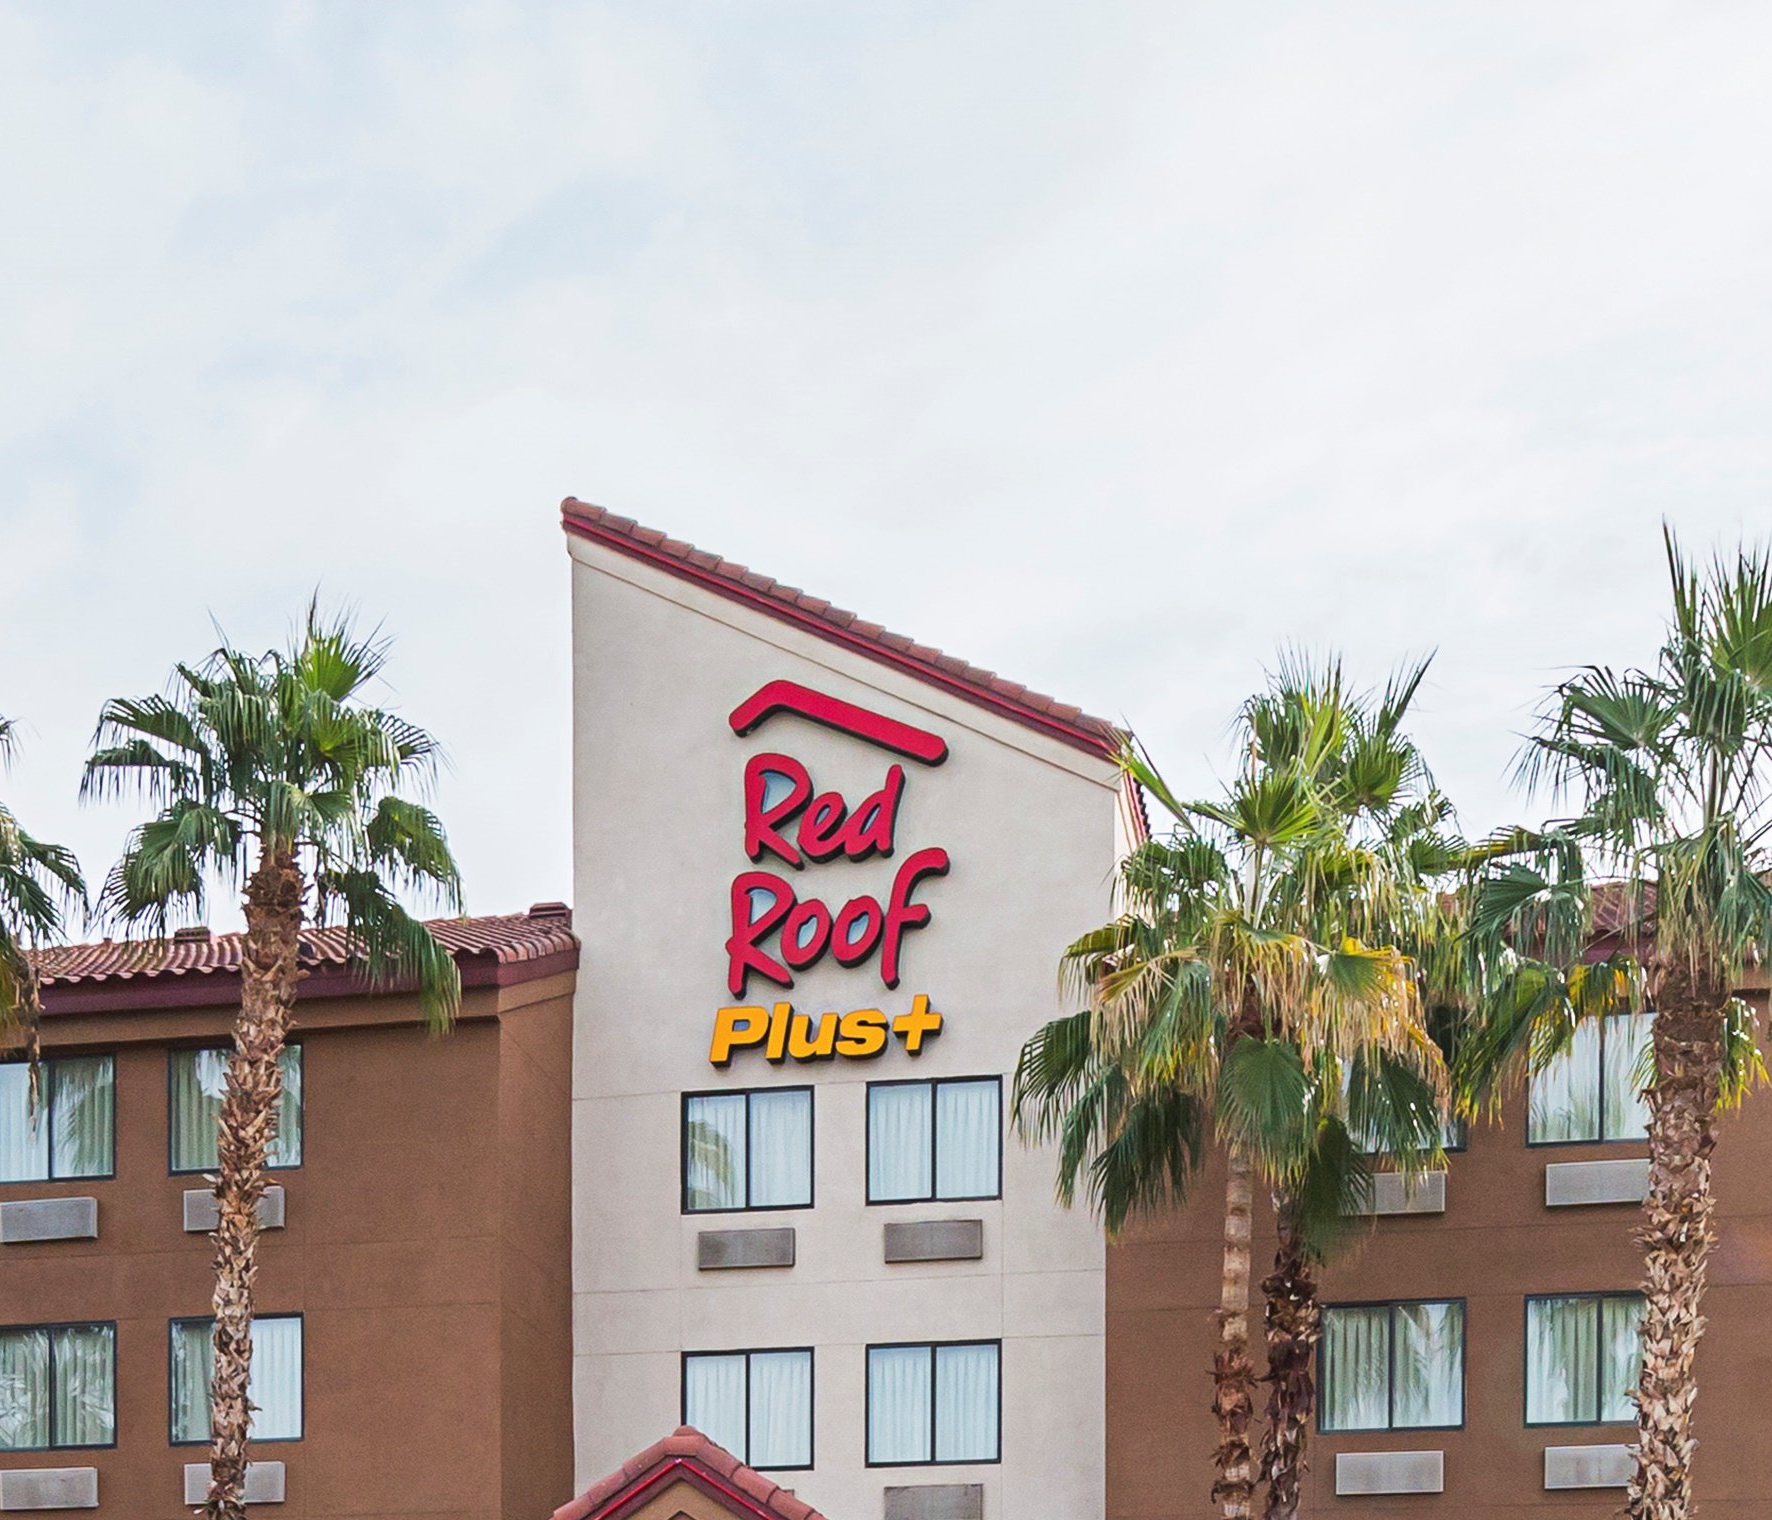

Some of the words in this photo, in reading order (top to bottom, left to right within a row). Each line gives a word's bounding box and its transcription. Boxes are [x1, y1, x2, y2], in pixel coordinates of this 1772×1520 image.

[744, 752, 905, 870] Red
[726, 847, 950, 1000] Roof
[709, 994, 943, 1068] Plus+
